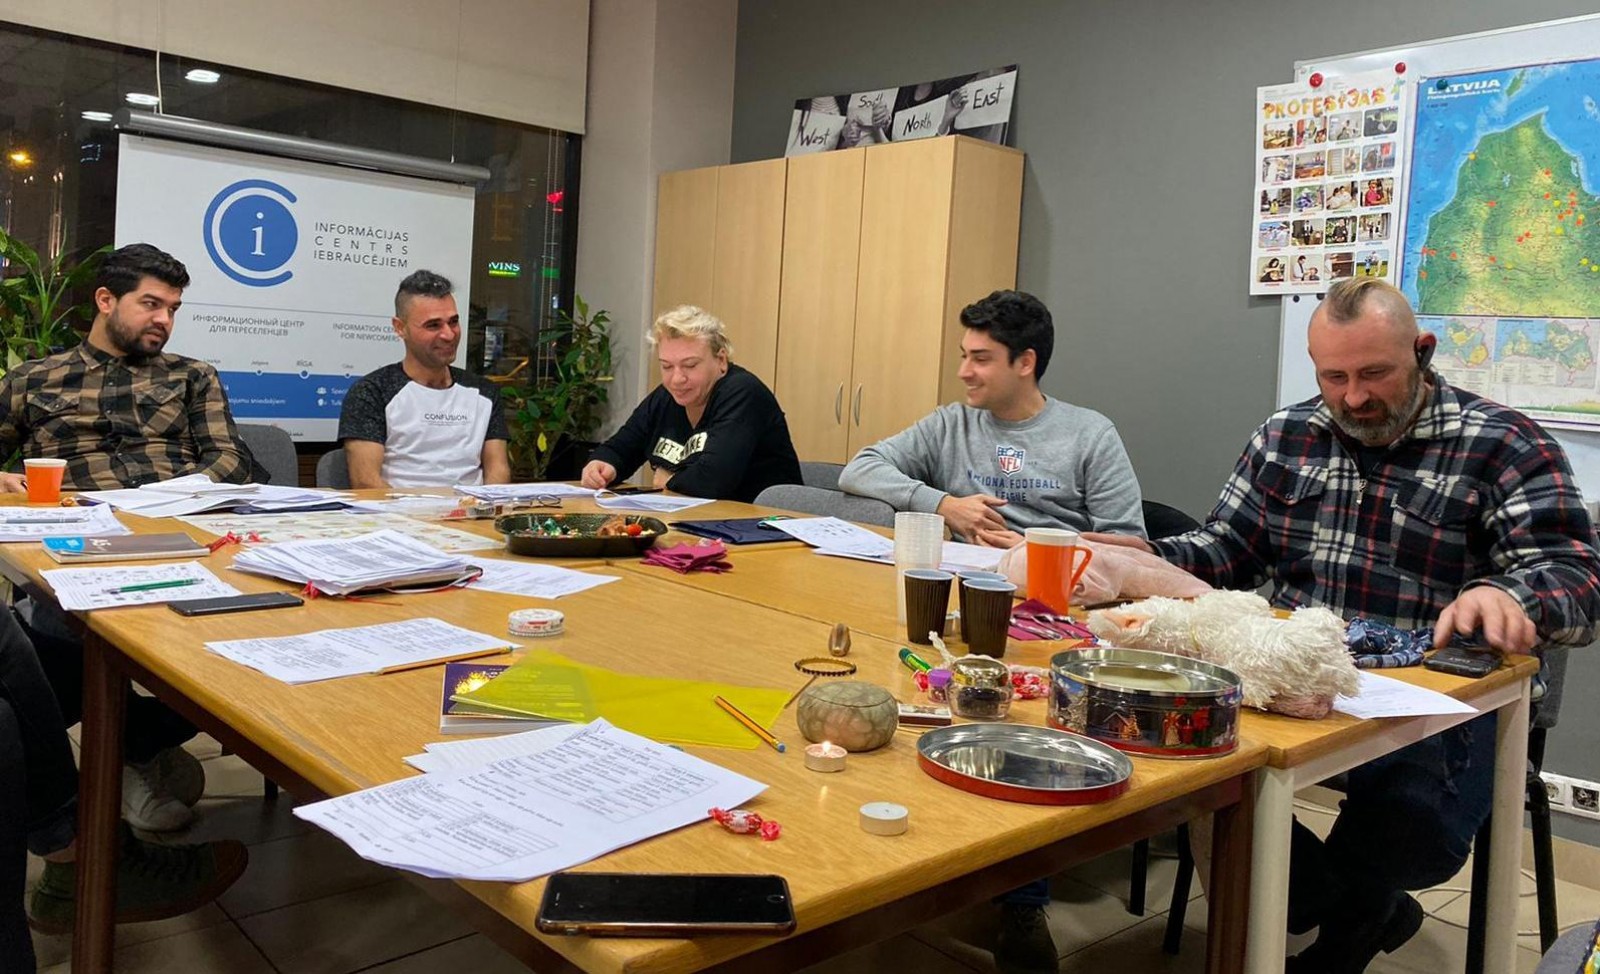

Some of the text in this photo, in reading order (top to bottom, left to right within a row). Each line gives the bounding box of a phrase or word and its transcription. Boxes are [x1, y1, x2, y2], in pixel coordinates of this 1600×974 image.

[1262, 87, 1387, 119] PROFESIJAS
[903, 112, 931, 135] North
[800, 127, 829, 147] West
[315, 221, 409, 242] INFORMĀCIJAS
[313, 249, 408, 268] IEBRAUCĒJIEM
[192, 314, 305, 328] ИНФОРМАЦИОННЫЙ ЦЕНТР
[333, 323, 381, 333] INFORMATION
[209, 324, 289, 337] ДЛЯ ПЕРЕСЕЛЕНЦЕВ
[341, 332, 355, 340] FOR
[999, 456, 1021, 471] NFL
[1009, 478, 1061, 490] FOOTBALL
